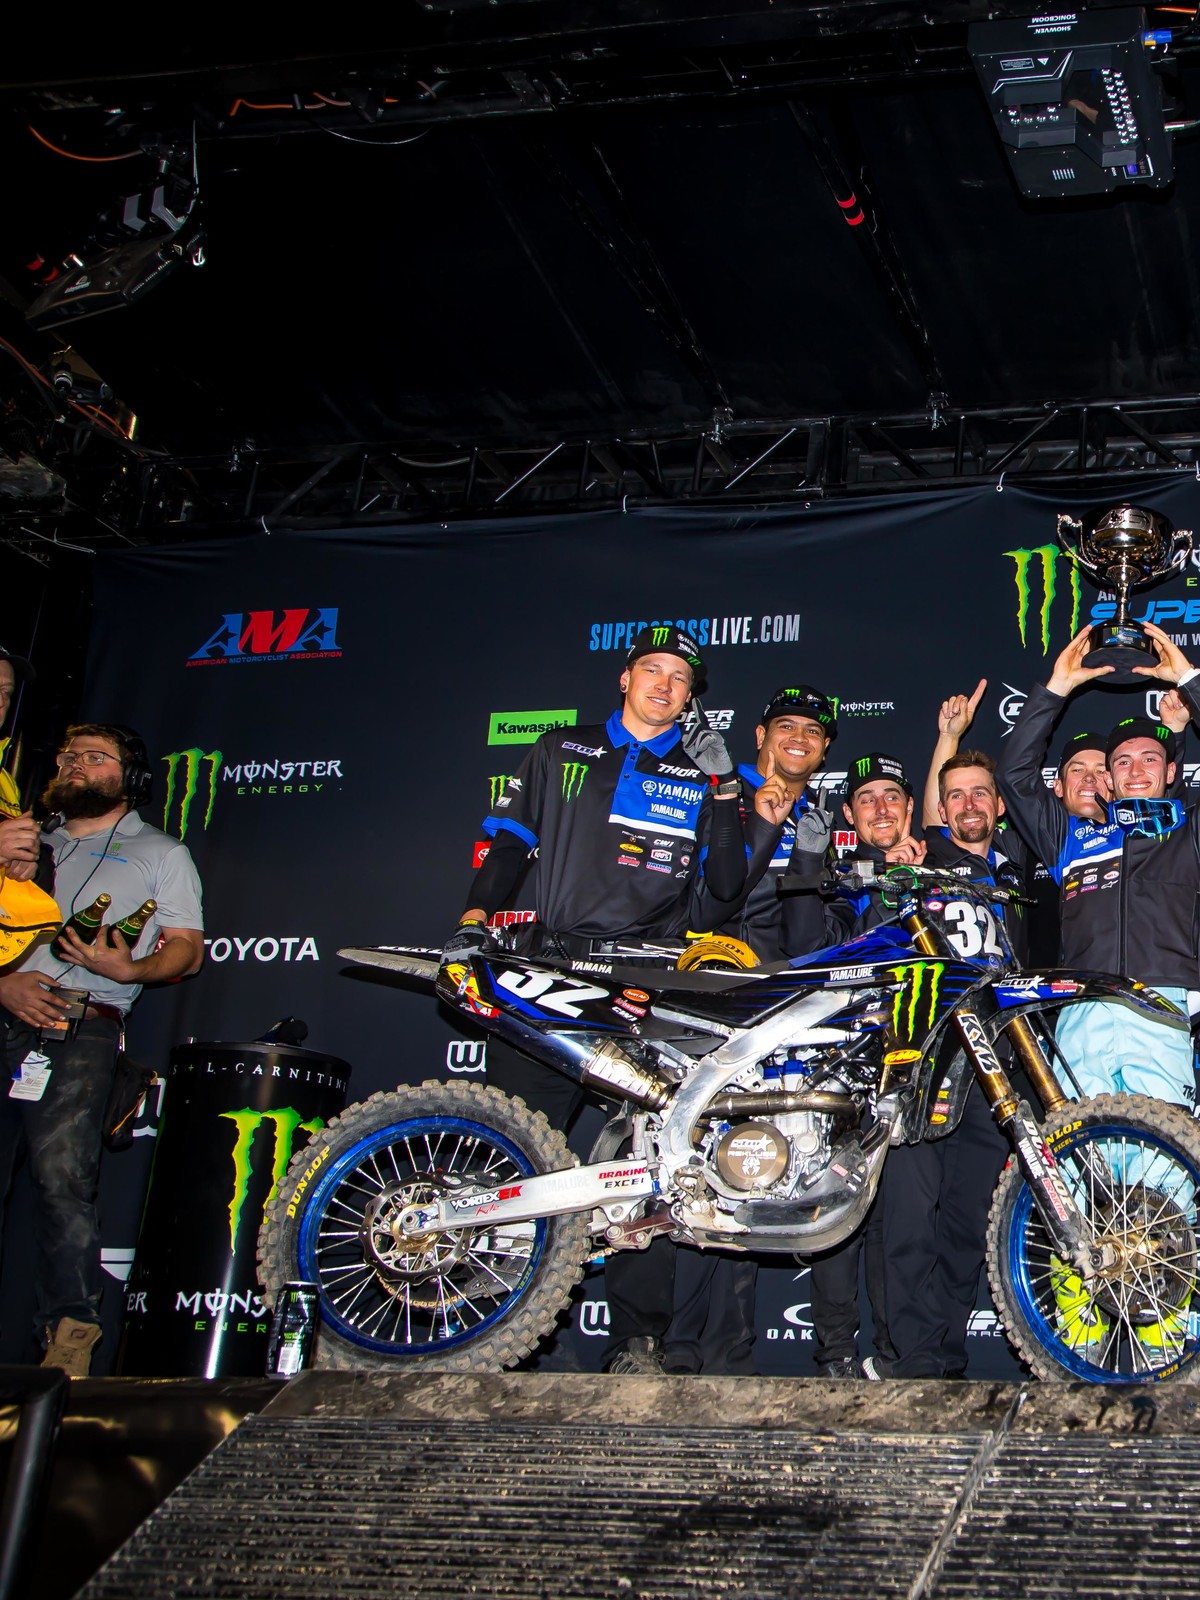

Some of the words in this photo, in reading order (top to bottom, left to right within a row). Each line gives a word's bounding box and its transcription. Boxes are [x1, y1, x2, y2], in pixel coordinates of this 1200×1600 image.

[1031, 13, 1077, 24] SONICBOOM
[188, 607, 343, 660] AMA
[589, 614, 801, 652] SUPESSLIVE.COM
[1168, 634, 1188, 646] IM
[186, 657, 228, 667] AMERICAN
[229, 653, 290, 664] MOTORCYCLIST
[290, 651, 343, 660] ASSOCIATION
[840, 701, 895, 712] MONSTER
[497, 720, 569, 735] Kawasaki
[223, 759, 344, 784] MONSTER
[656, 763, 702, 779] THOR
[237, 784, 324, 796] ENERGY
[657, 782, 703, 801] YAMAHA
[650, 803, 688, 820] YAMALUBE
[945, 901, 1005, 958] 32
[205, 937, 321, 962] TOYOTA
[570, 960, 614, 975] YAMAHA
[828, 966, 874, 981] YAMALUBE
[496, 965, 611, 1019] 32
[957, 1012, 1002, 1075] KYB
[1046, 1120, 1084, 1144] NLOP
[1017, 1136, 1045, 1180] YAMALUBE
[1022, 1120, 1076, 1215] DULOP
[286, 1145, 332, 1220] DUNLOP
[598, 1166, 648, 1180] BRAKING
[450, 1190, 500, 1212] VORTEX
[498, 1185, 524, 1201] EK
[1041, 1177, 1069, 1222] BRAKING
[174, 1287, 268, 1318] MONS
[194, 1321, 268, 1334] ENER
[766, 1327, 813, 1341] OAK
